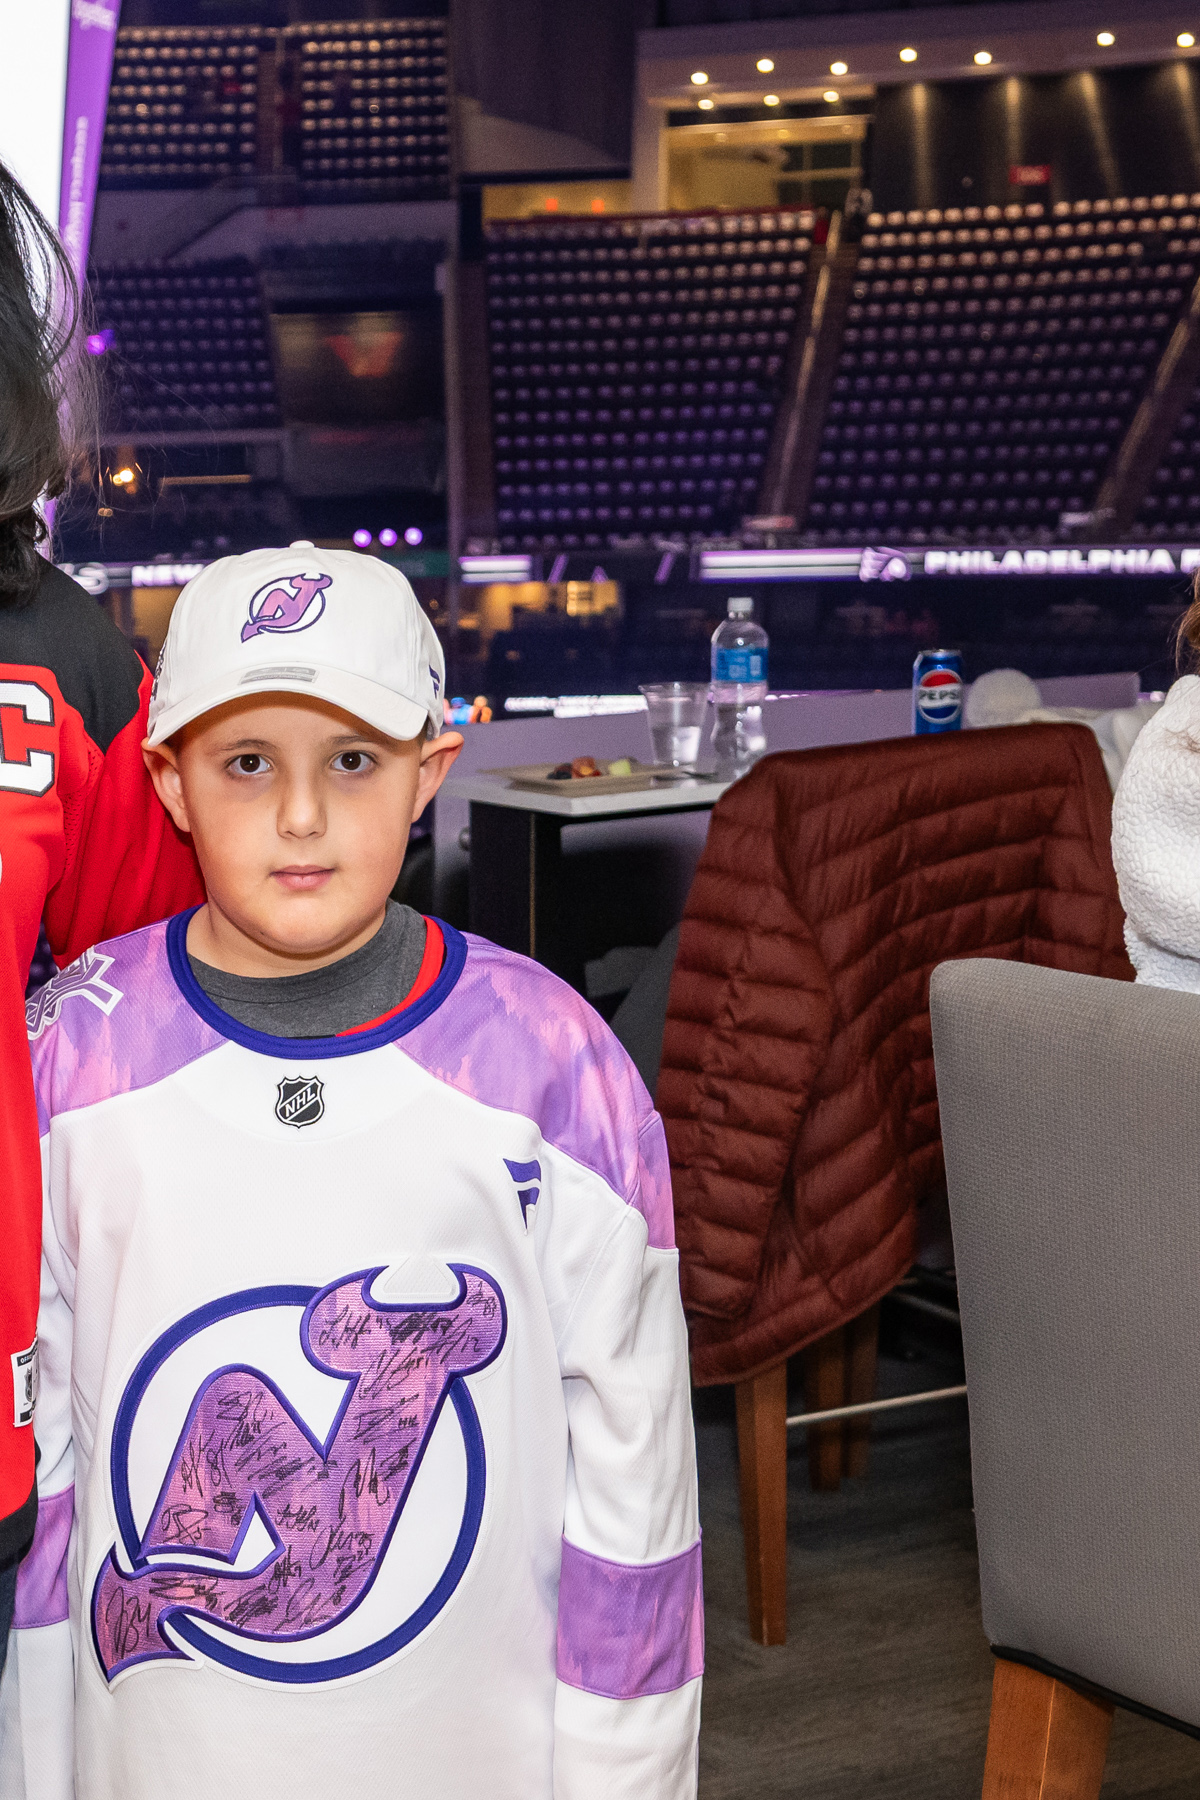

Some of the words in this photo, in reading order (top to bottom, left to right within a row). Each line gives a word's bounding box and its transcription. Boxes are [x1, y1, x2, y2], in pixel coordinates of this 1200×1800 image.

[924, 549, 1176, 575] PHILADELPHIA
[918, 689, 960, 701] PEPS
[284, 1086, 316, 1118] NHL
